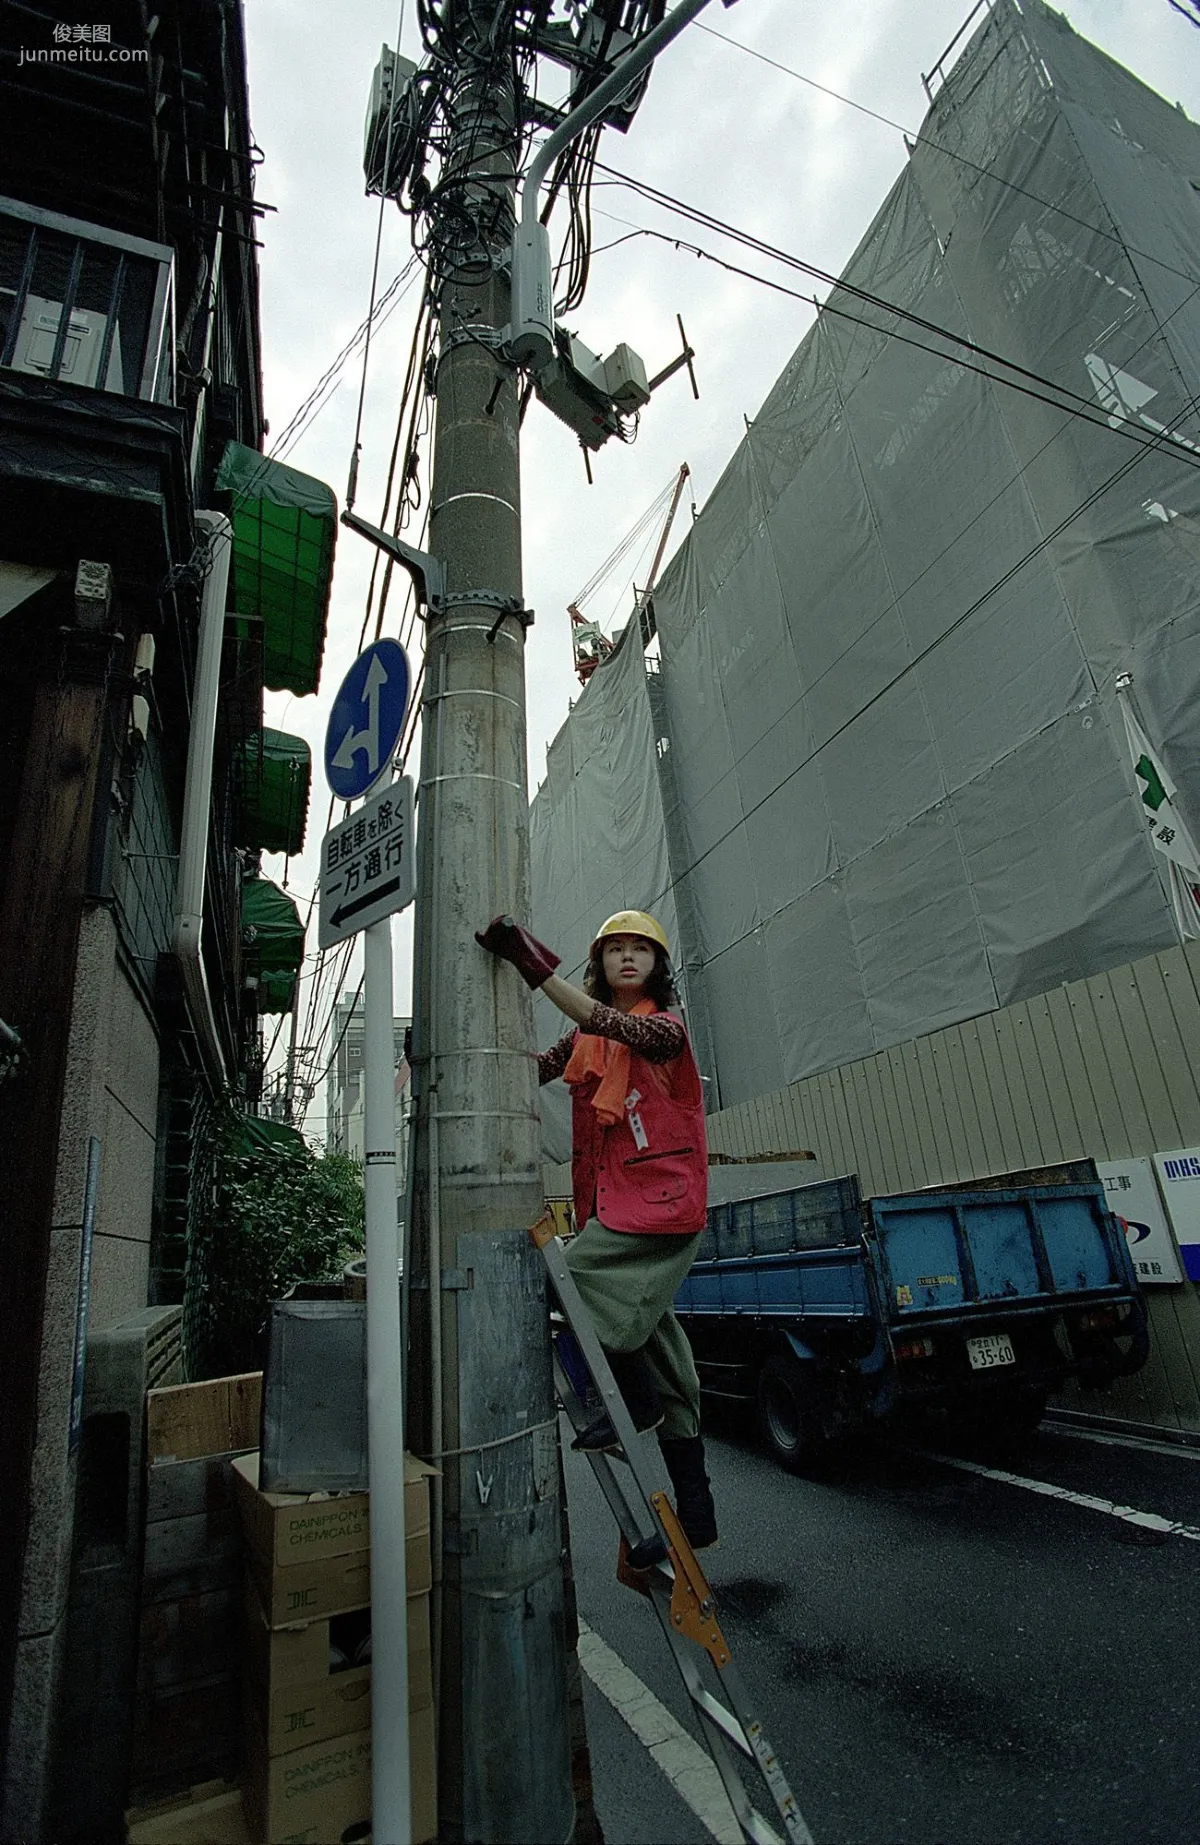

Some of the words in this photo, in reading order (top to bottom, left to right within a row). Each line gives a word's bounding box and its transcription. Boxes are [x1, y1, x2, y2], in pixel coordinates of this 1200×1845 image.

[327, 799, 404, 869] 自転車を除く
[325, 832, 404, 896] 一方通行
[1101, 1175, 1132, 1192] 工事
[289, 1509, 358, 1532] DAINIPPON
[289, 1523, 362, 1546] CHEMICALS
